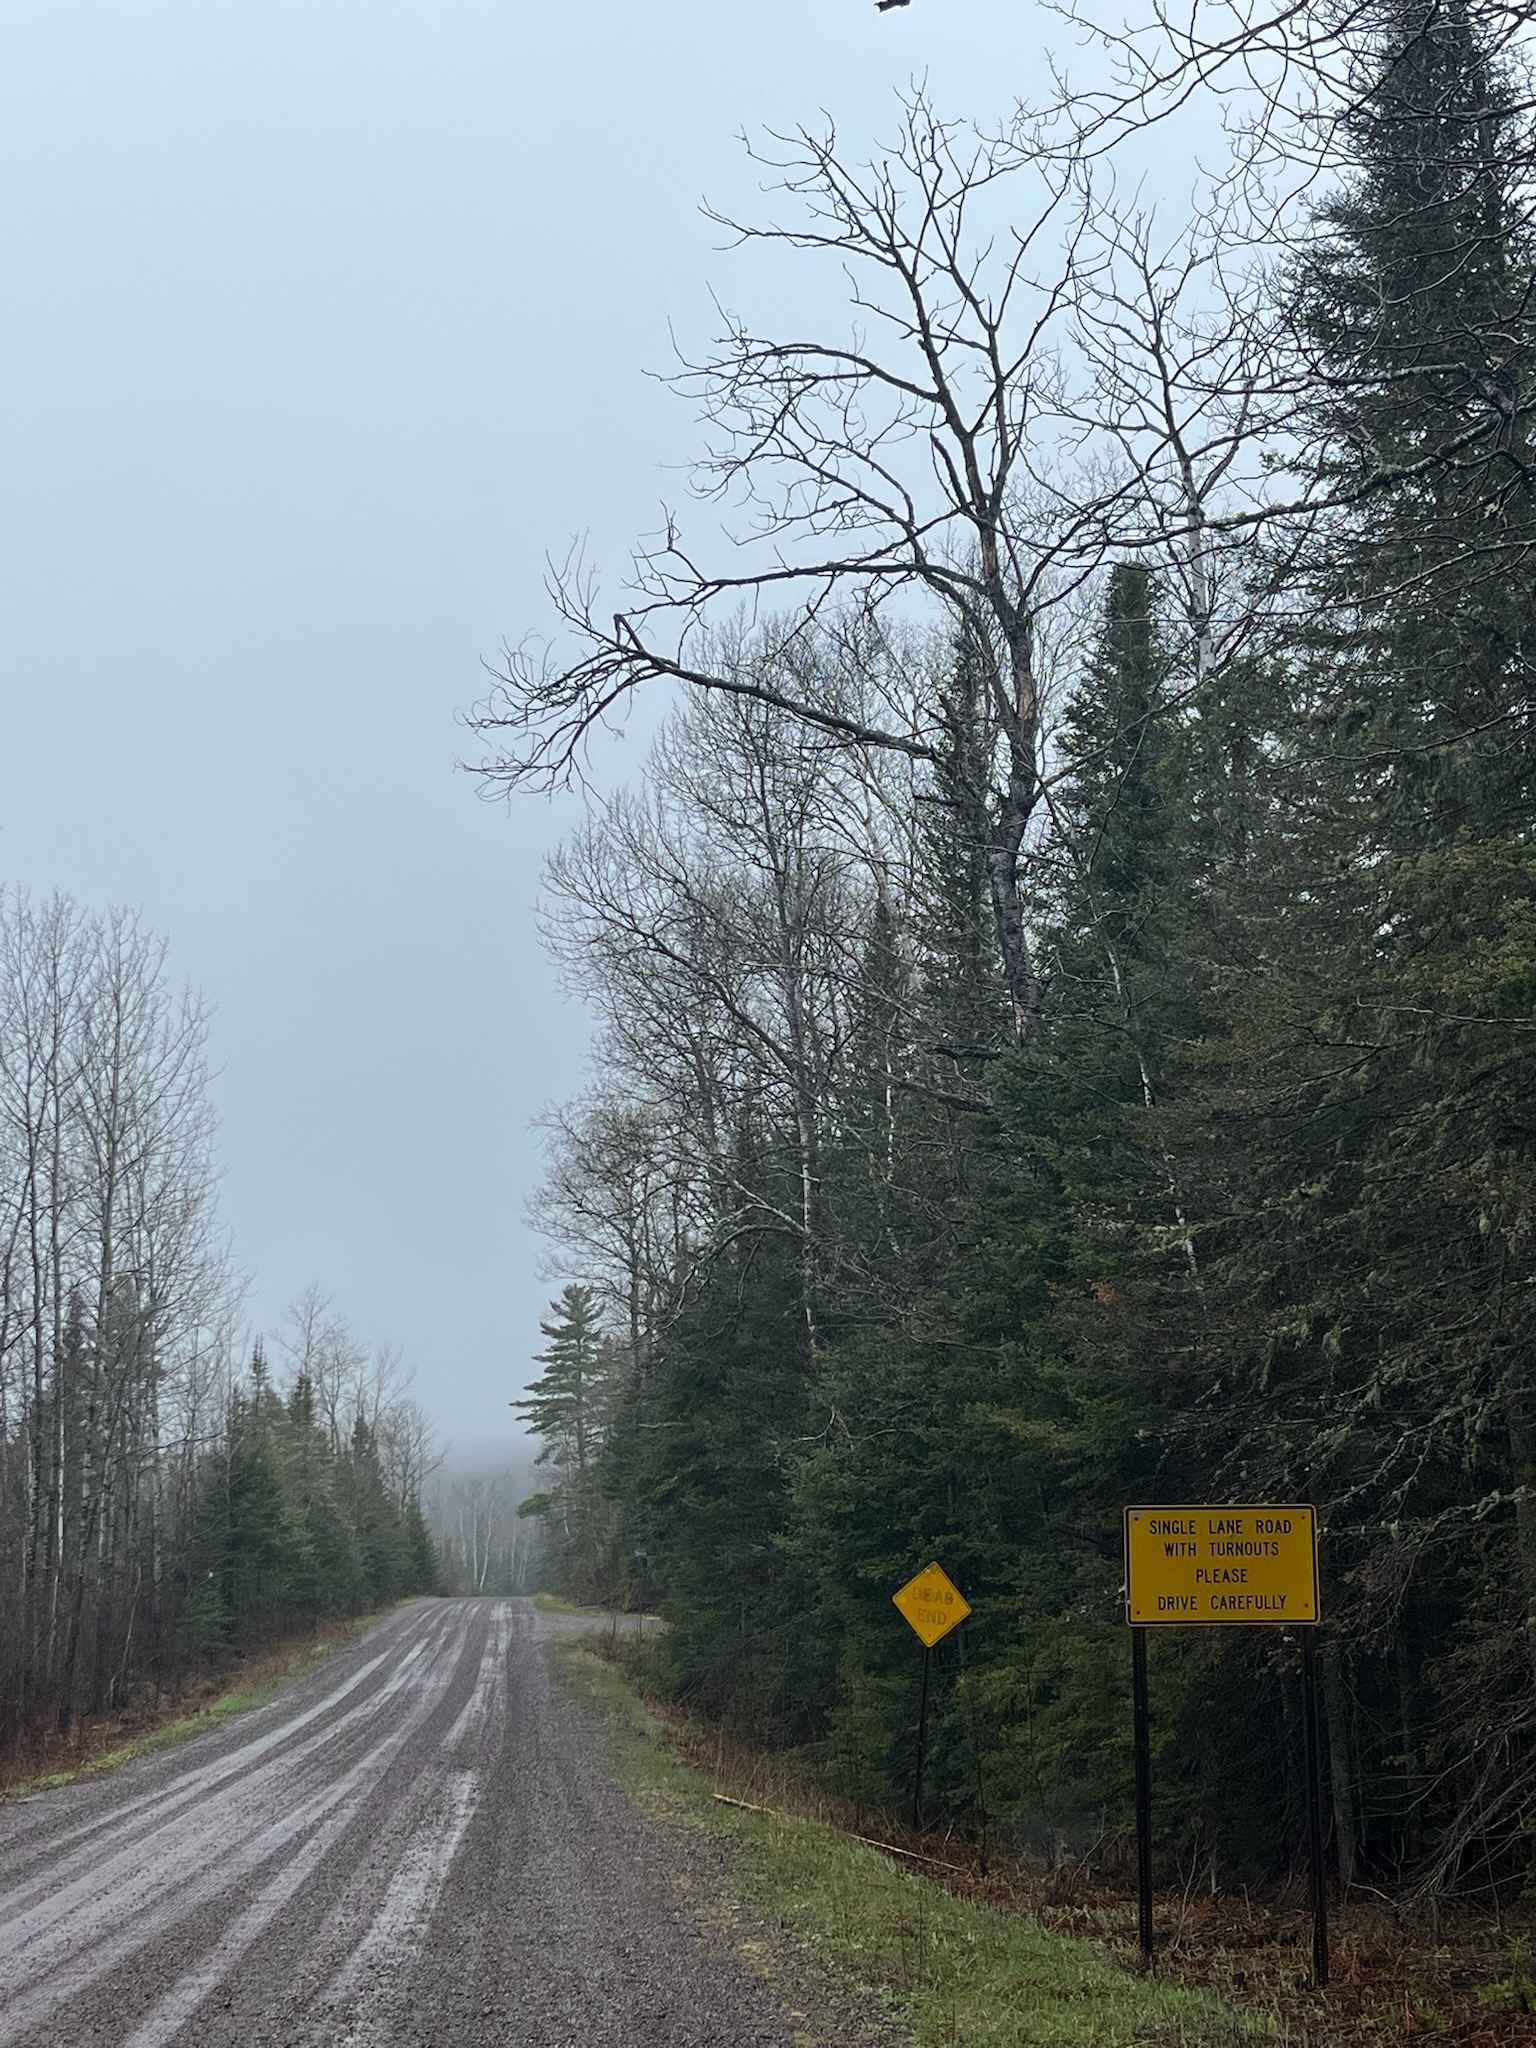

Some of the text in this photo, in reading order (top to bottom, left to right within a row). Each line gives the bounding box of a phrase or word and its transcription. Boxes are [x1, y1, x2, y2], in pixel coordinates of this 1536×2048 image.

[1150, 1519, 1292, 1535] SINGLE LANE ROAD
[1164, 1541, 1280, 1557] WITH TURNOUTS
[1196, 1568, 1248, 1583] PLEASE
[1158, 1595, 1287, 1611] DRIVE CAREFULLY
[919, 1608, 947, 1626] END
